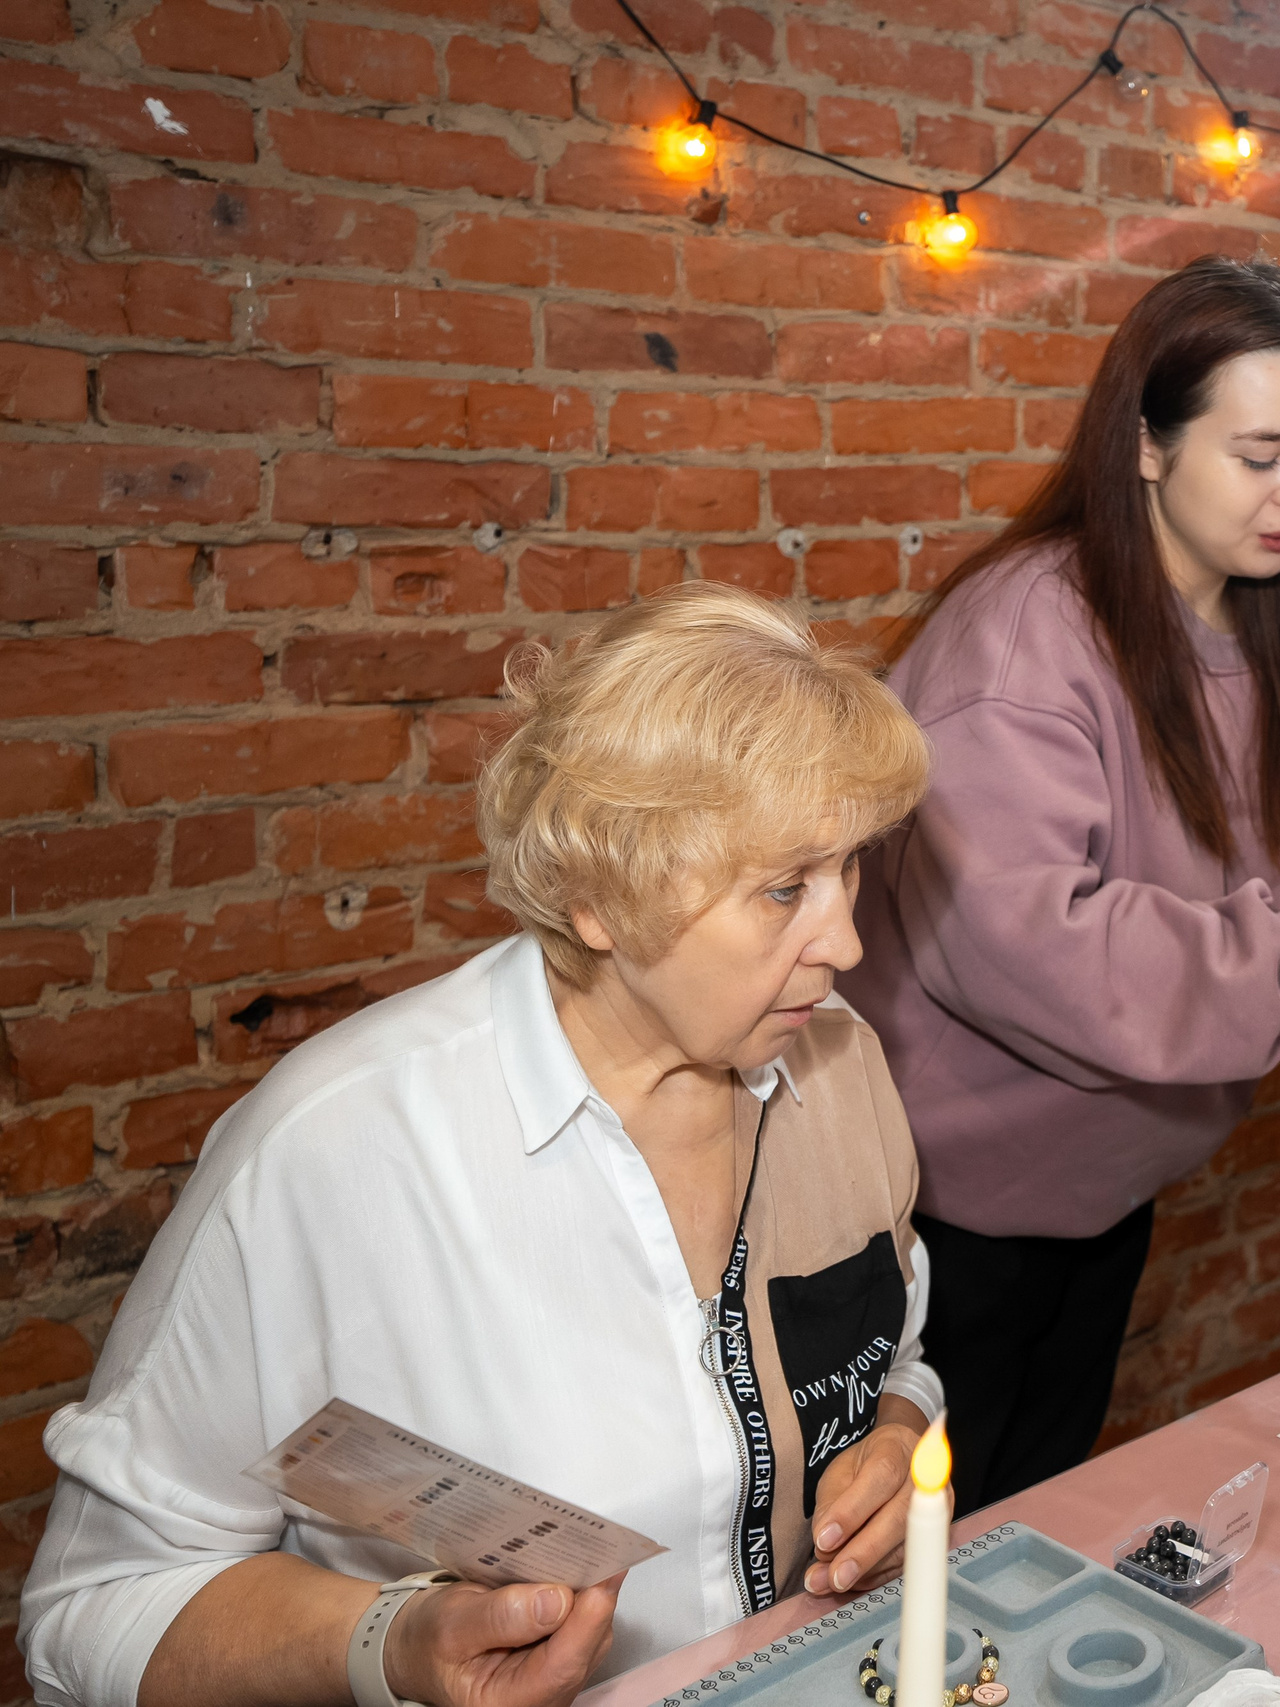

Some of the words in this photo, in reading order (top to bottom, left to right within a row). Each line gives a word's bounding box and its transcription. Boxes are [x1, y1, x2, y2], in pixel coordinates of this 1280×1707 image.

[725, 1309, 758, 1402] INSPIRE
[746, 1411, 771, 1508] OTHERS
[792, 1371, 844, 1407] OWN
[847, 1337, 892, 1379] YOUR
